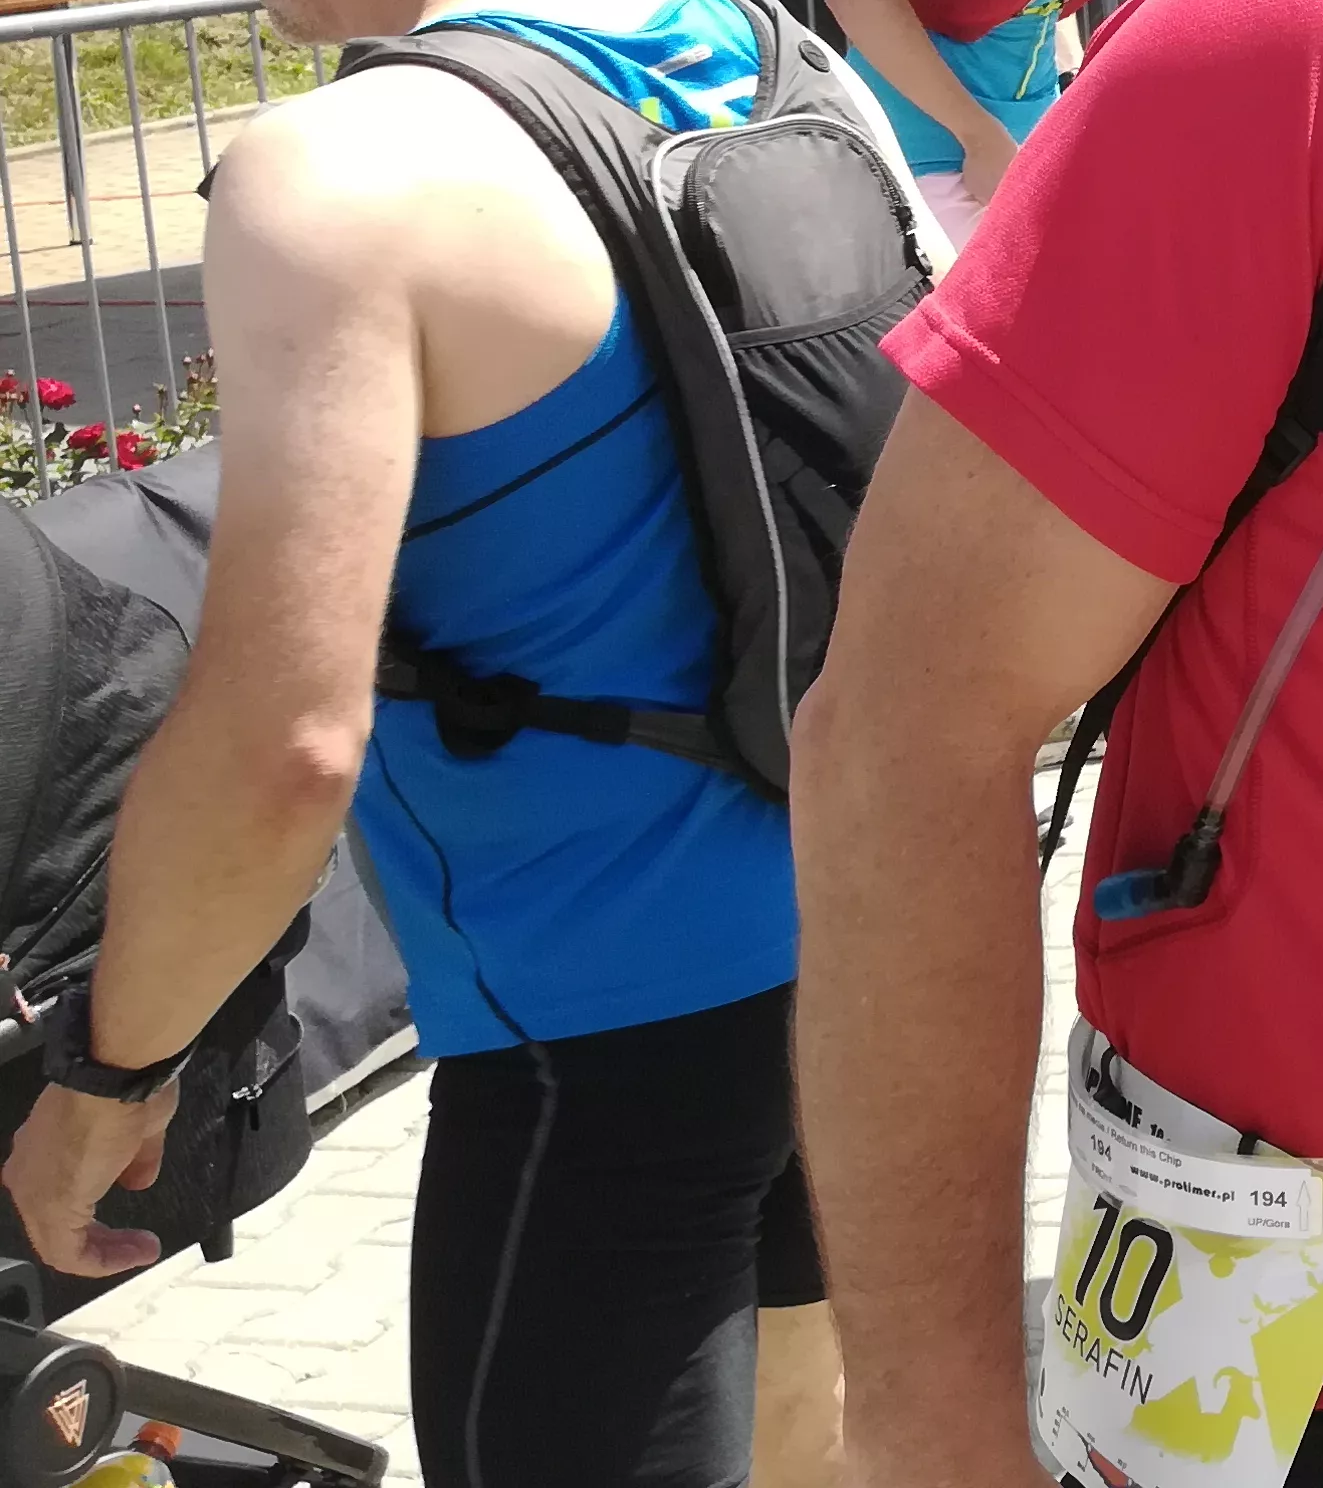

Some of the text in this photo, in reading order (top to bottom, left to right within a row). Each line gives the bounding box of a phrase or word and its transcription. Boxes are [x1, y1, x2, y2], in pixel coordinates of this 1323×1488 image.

[1129, 1164, 1288, 1208] www.protimer.pl 194
[1158, 1150, 1182, 1167] Chip
[1074, 1190, 1174, 1342] 10
[1054, 1293, 1154, 1405] SERAFIN
